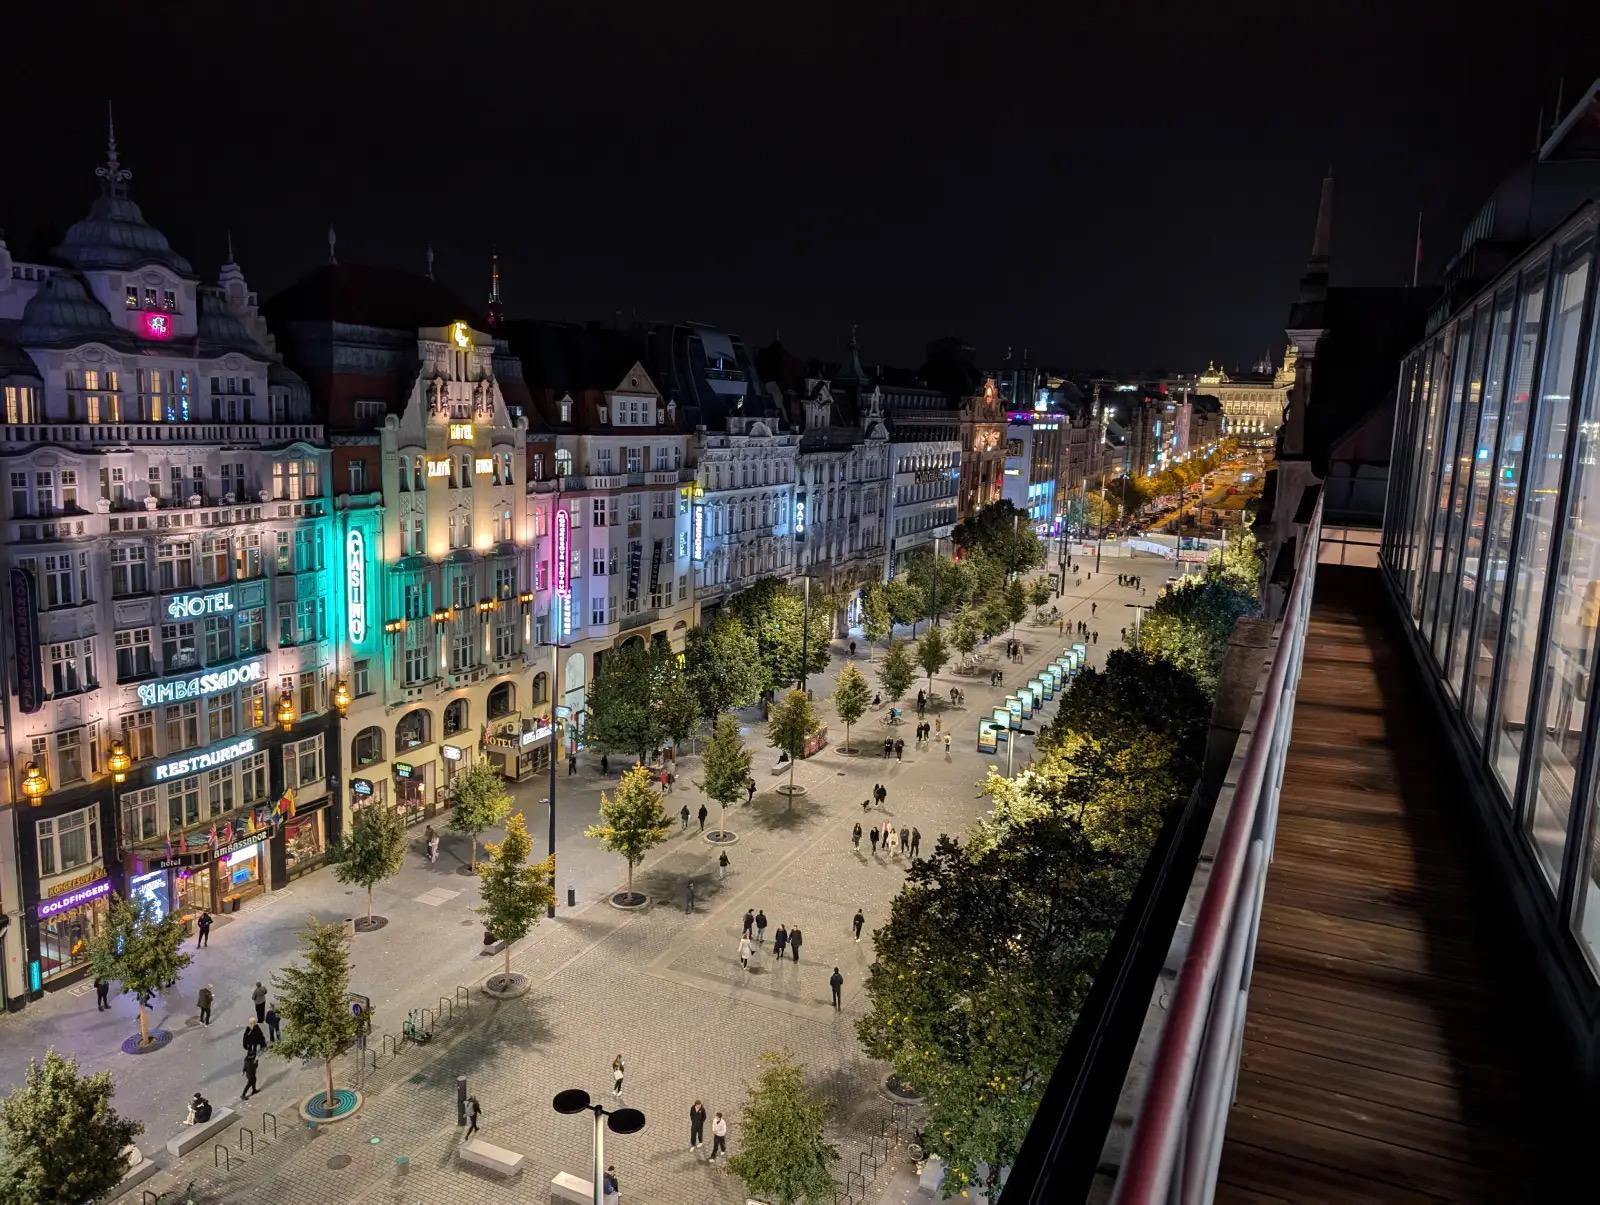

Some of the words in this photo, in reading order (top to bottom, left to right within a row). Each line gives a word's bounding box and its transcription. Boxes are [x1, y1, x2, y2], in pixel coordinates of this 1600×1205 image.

[168, 592, 234, 618] HOTEL
[350, 539, 361, 636] CASINO
[137, 662, 261, 706] AMBASSADOR
[156, 738, 255, 780] RESTAURACE
[42, 883, 110, 914] GOLDFINGERS
